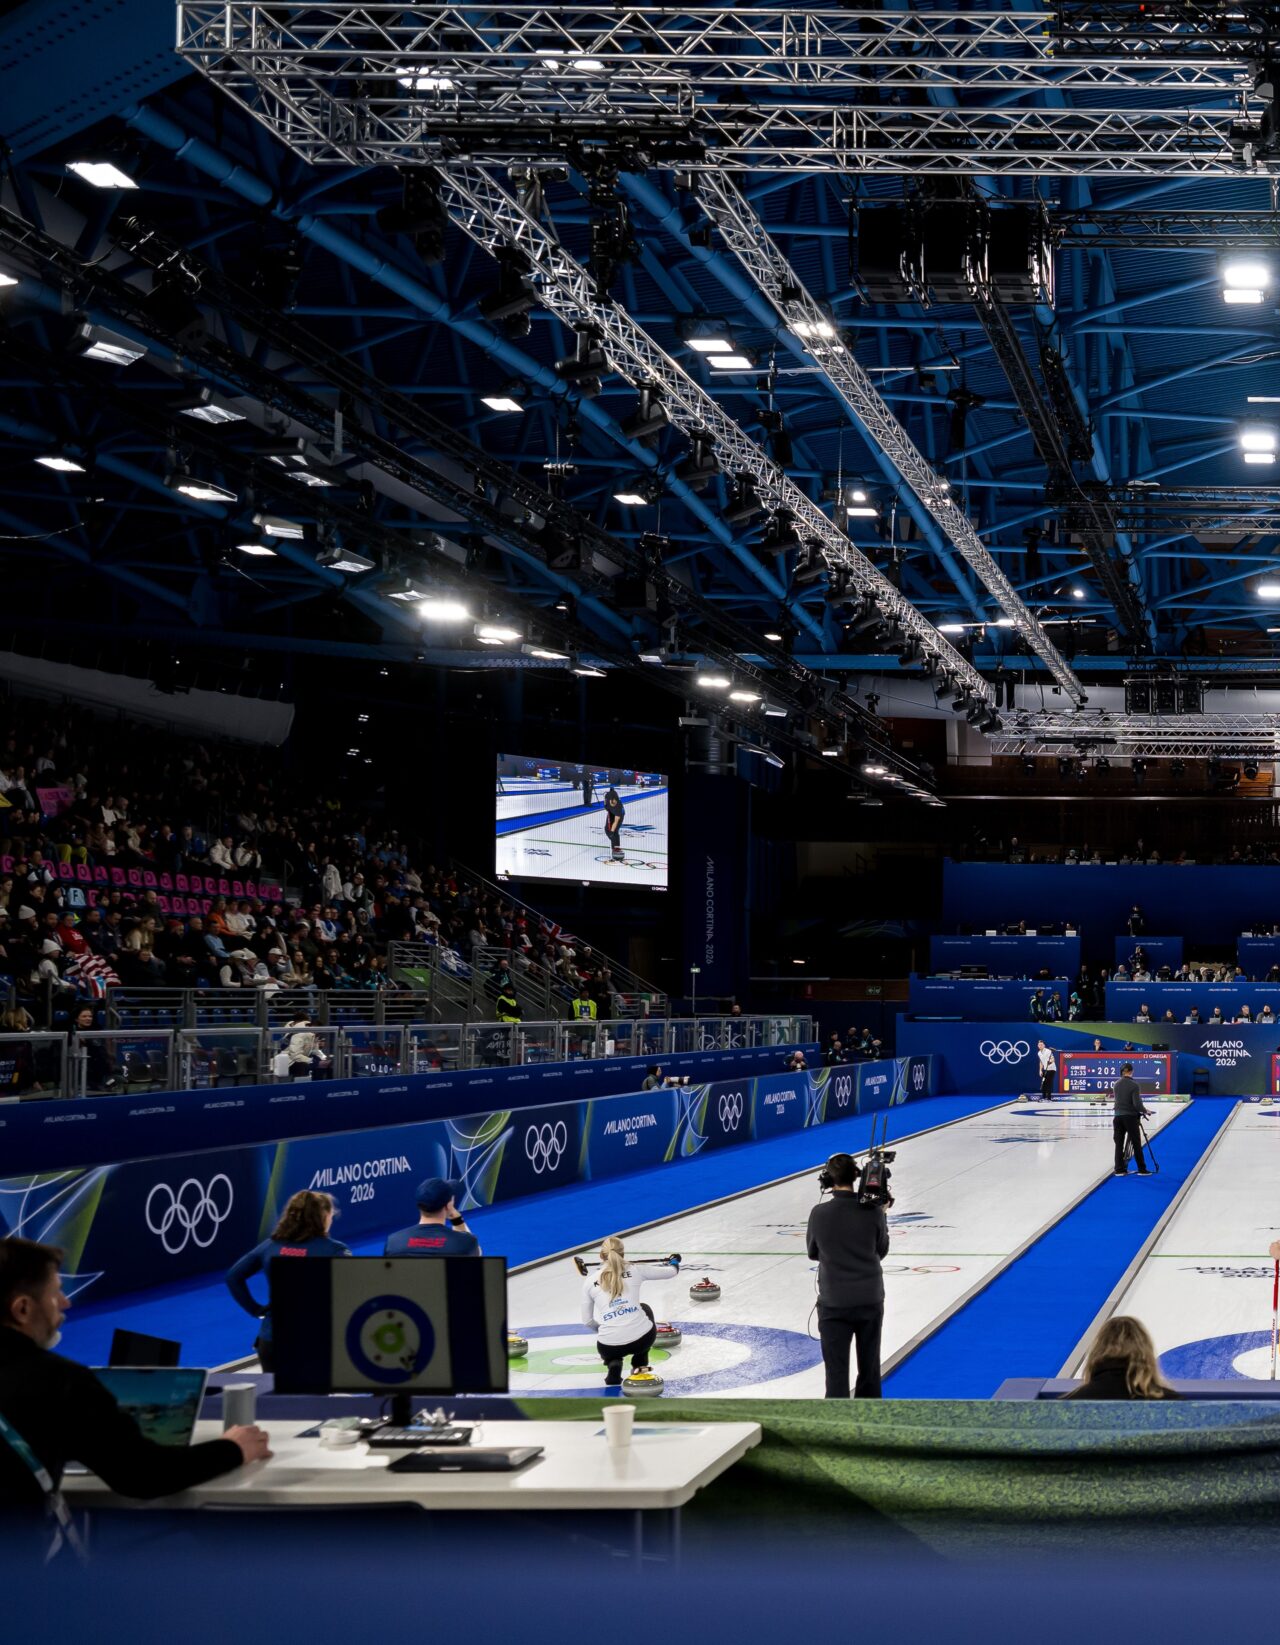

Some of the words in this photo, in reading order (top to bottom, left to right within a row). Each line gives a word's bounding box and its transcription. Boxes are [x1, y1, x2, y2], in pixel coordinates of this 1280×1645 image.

[704, 855, 715, 897] MILANO
[705, 898, 714, 943] CORTINA
[706, 944, 714, 965] 2026
[1200, 1040, 1243, 1048] MILANO
[1207, 1049, 1252, 1057] CORTINA
[1215, 1058, 1236, 1066] 2026
[1097, 1067, 1102, 1075] 2
[1104, 1067, 1109, 1075] 0
[1110, 1067, 1116, 1075] 2
[1097, 1081, 1102, 1089] 0
[1104, 1081, 1109, 1089] 2
[763, 1092, 780, 1105] MILANO
[780, 1090, 797, 1102] CORTINA
[603, 1118, 631, 1135] MILANO
[631, 1113, 657, 1130] CORTINA
[625, 1132, 638, 1147] 2026
[308, 1163, 362, 1190] MILANO
[362, 1156, 412, 1180] CORTINA
[350, 1182, 375, 1204] 2026
[603, 1306, 639, 1321] ESTONIA
